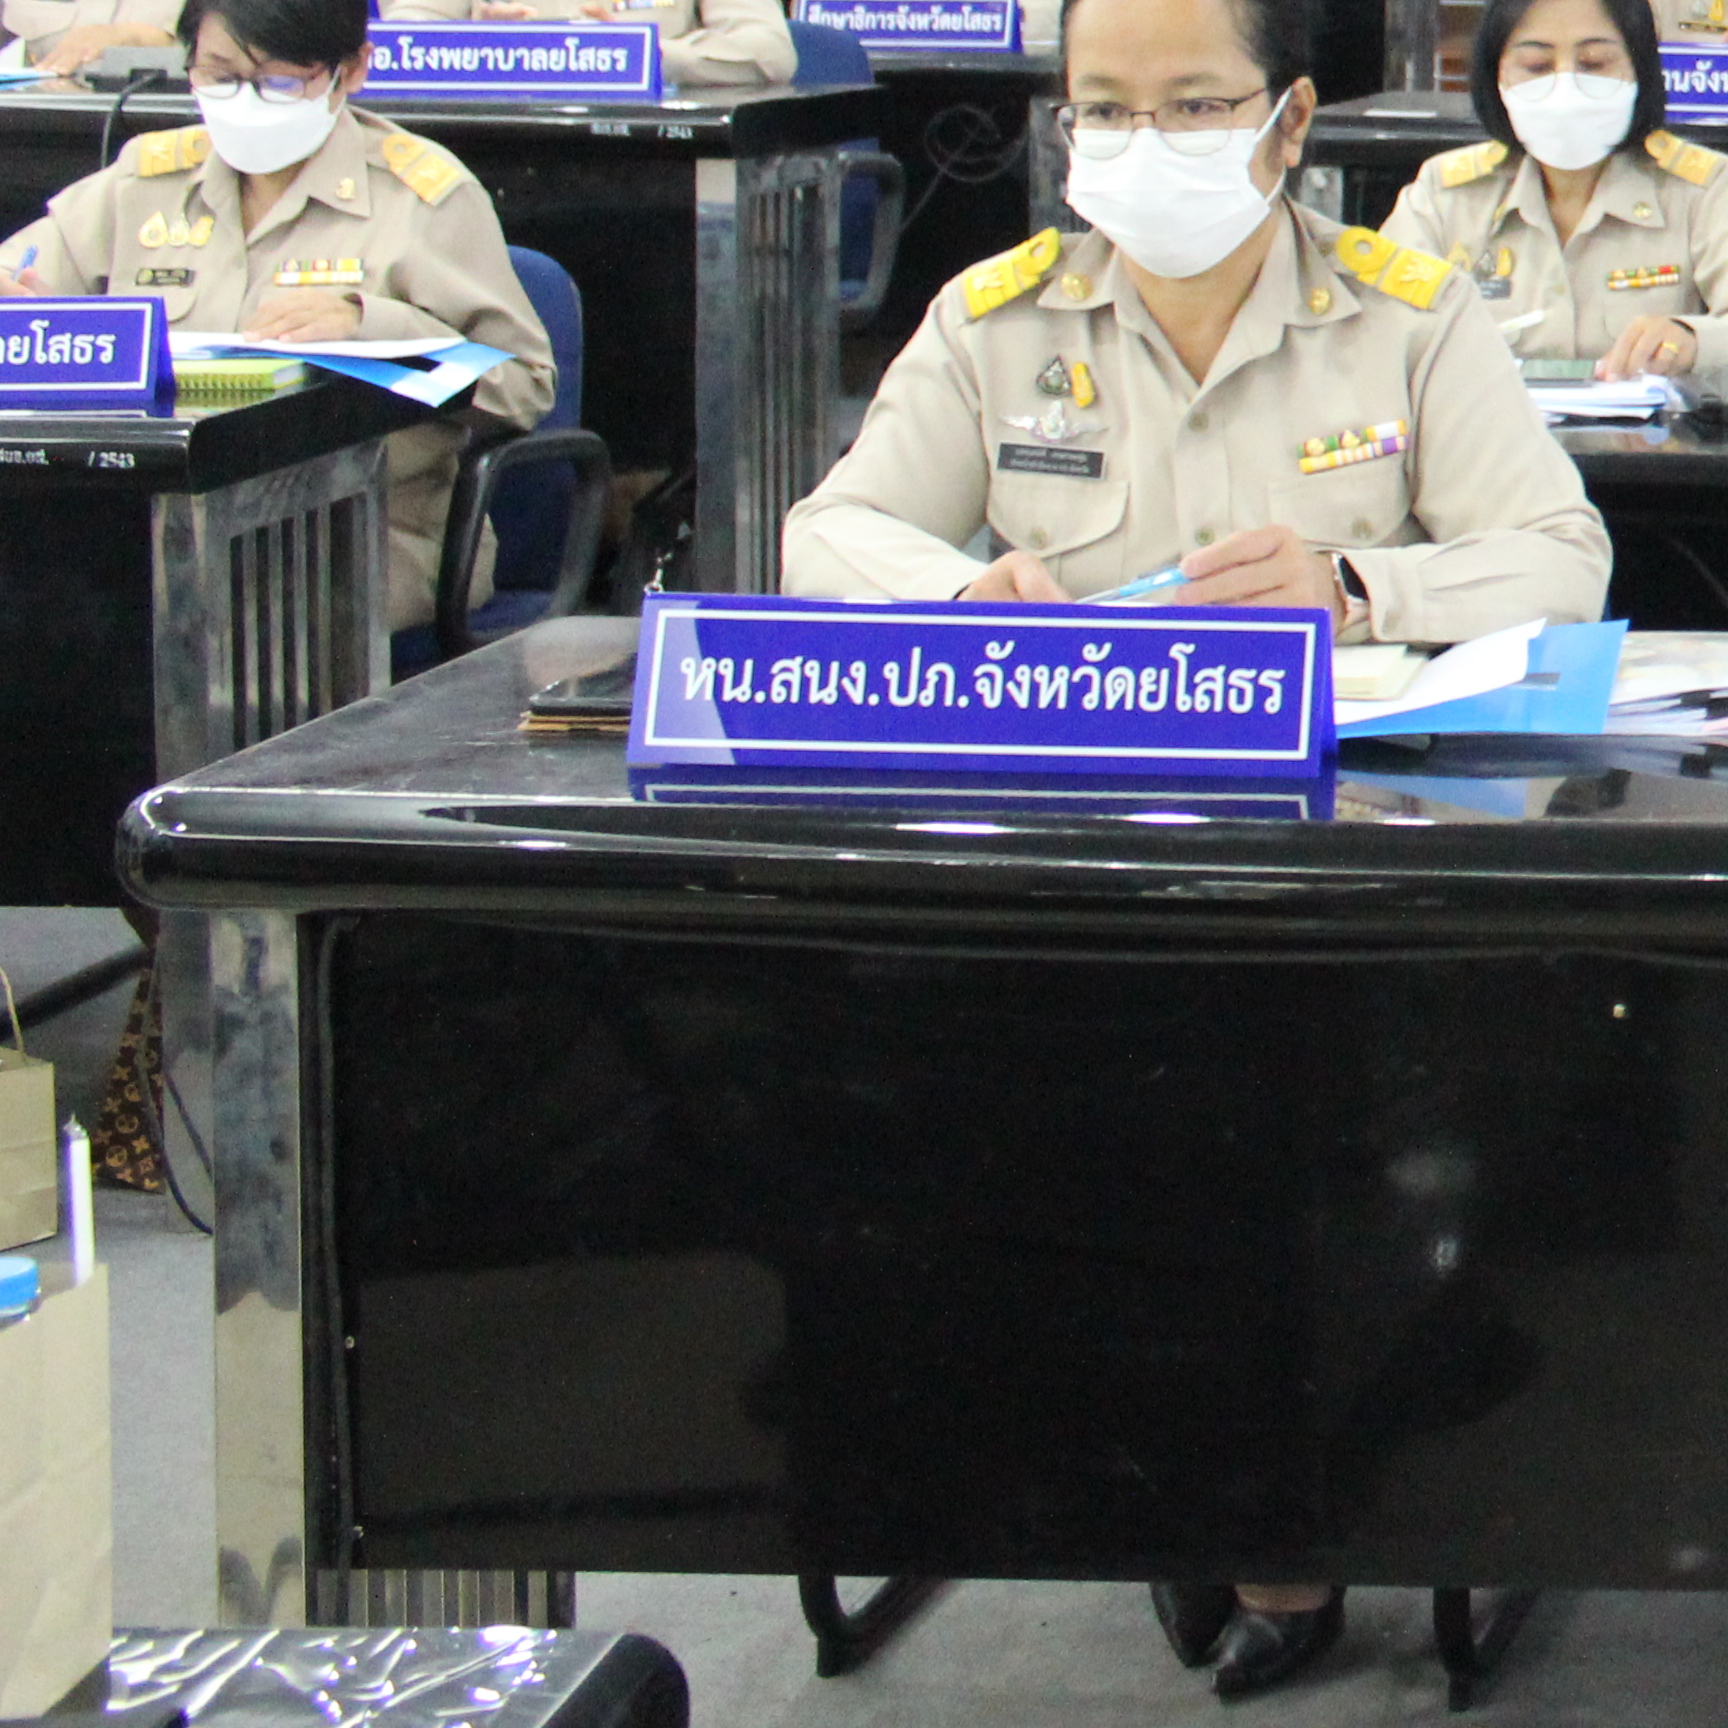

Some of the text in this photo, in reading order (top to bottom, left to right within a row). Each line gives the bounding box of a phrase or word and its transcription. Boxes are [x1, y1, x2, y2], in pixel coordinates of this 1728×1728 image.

[367, 36, 628, 72] อ.โรงพยาบาลยโสธร
[98, 452, 136, 469] 2543
[680, 640, 1286, 715] หน.สนง.ปภ.จังหวัดยโสธร
